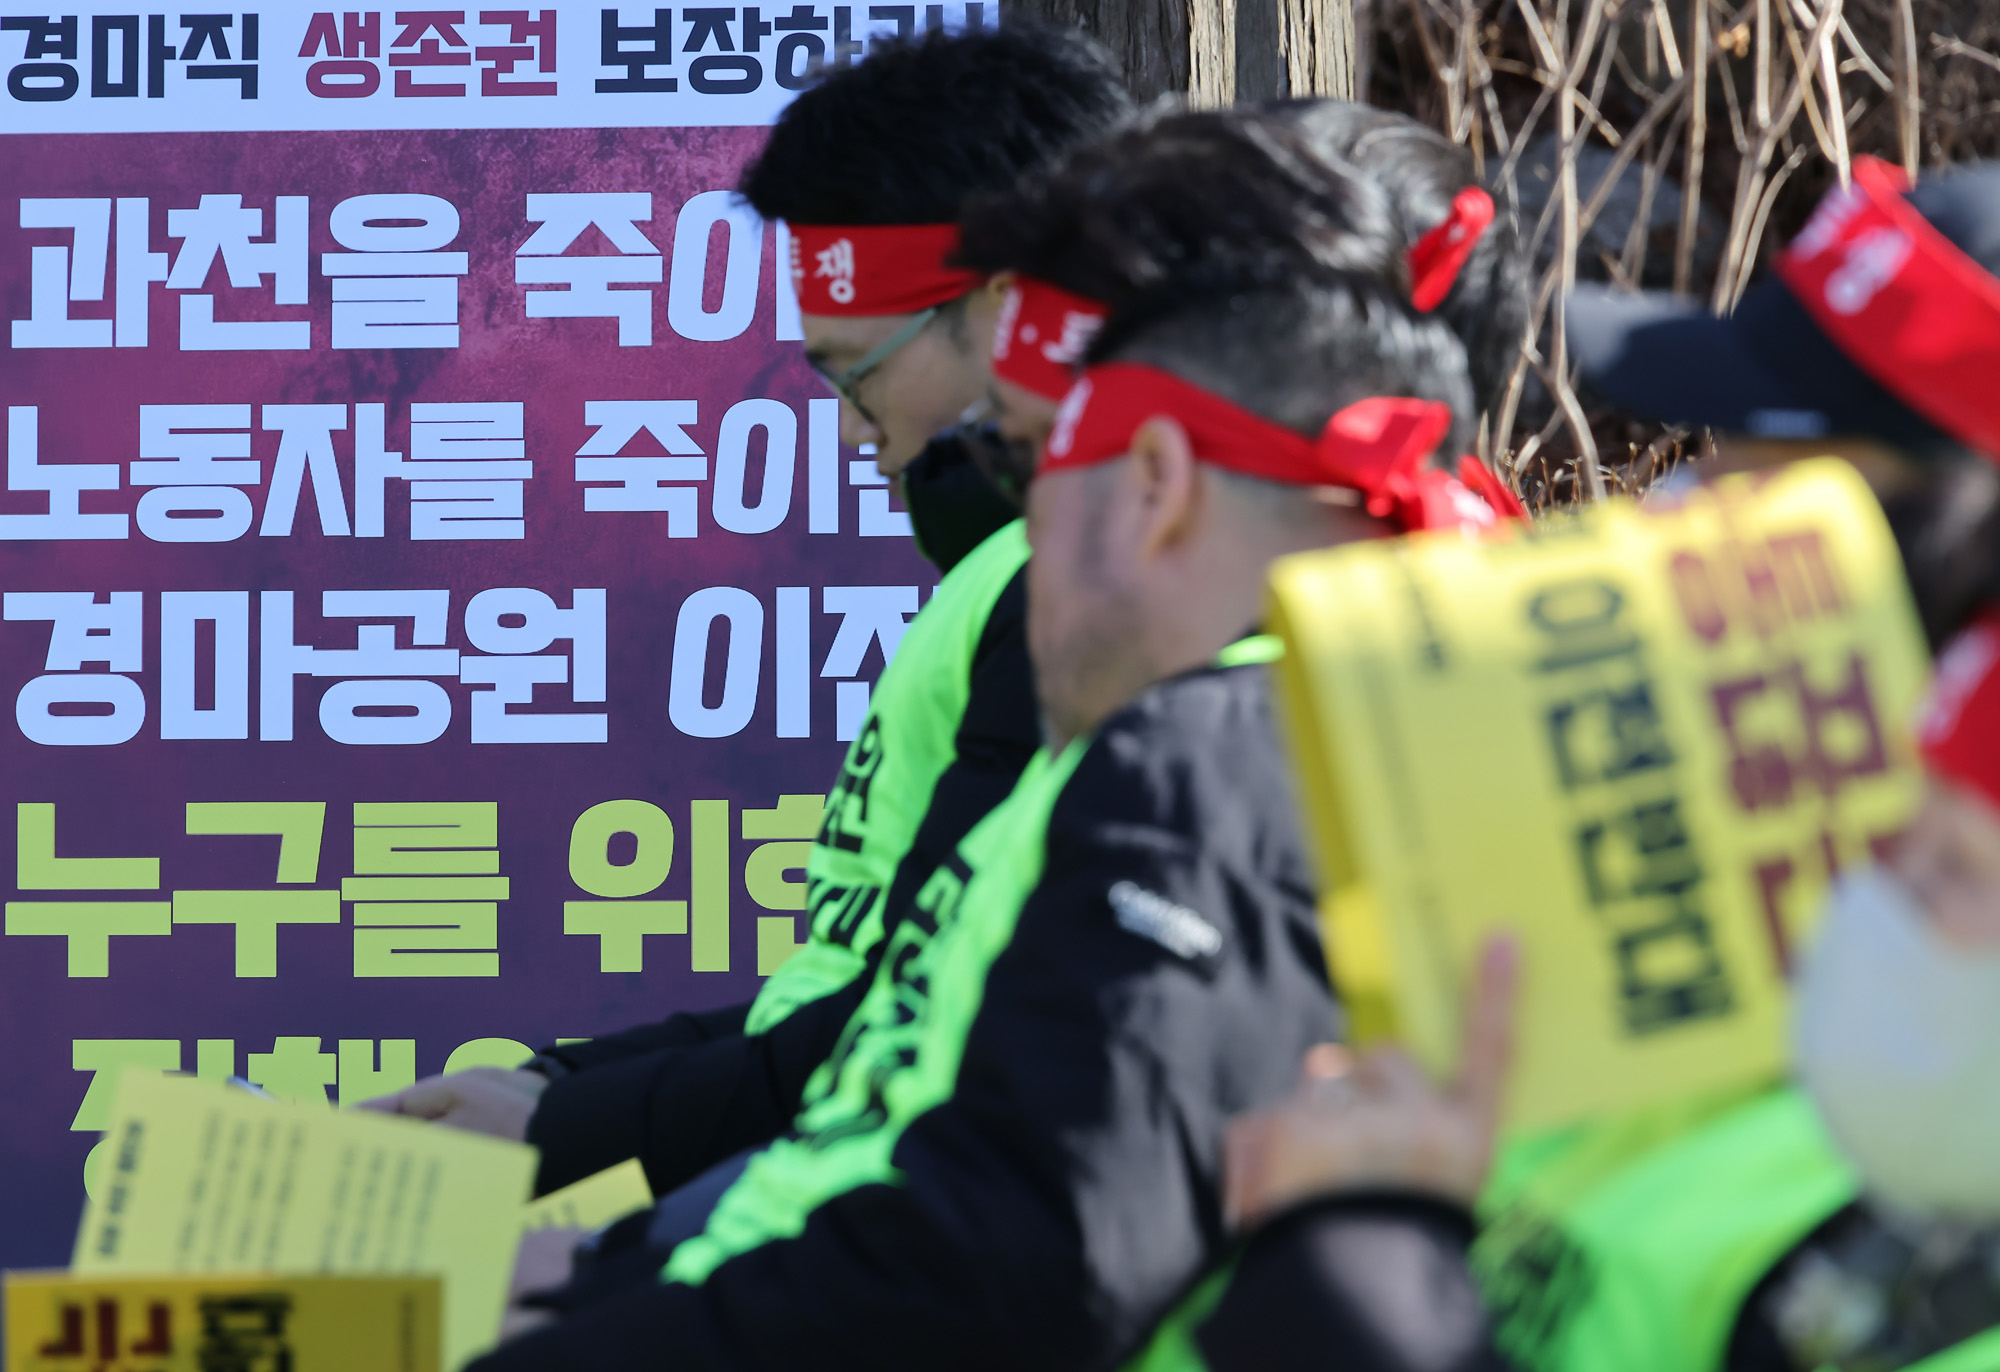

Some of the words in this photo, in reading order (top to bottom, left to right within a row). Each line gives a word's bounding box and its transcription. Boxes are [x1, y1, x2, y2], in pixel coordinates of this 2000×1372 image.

[0, 13, 259, 102] 경마직
[298, 9, 558, 99] 생존권
[11, 193, 469, 351] 과천을
[0, 401, 533, 543] 노동자를
[3, 587, 608, 746] 경마공원
[5, 801, 510, 978] 누구를
